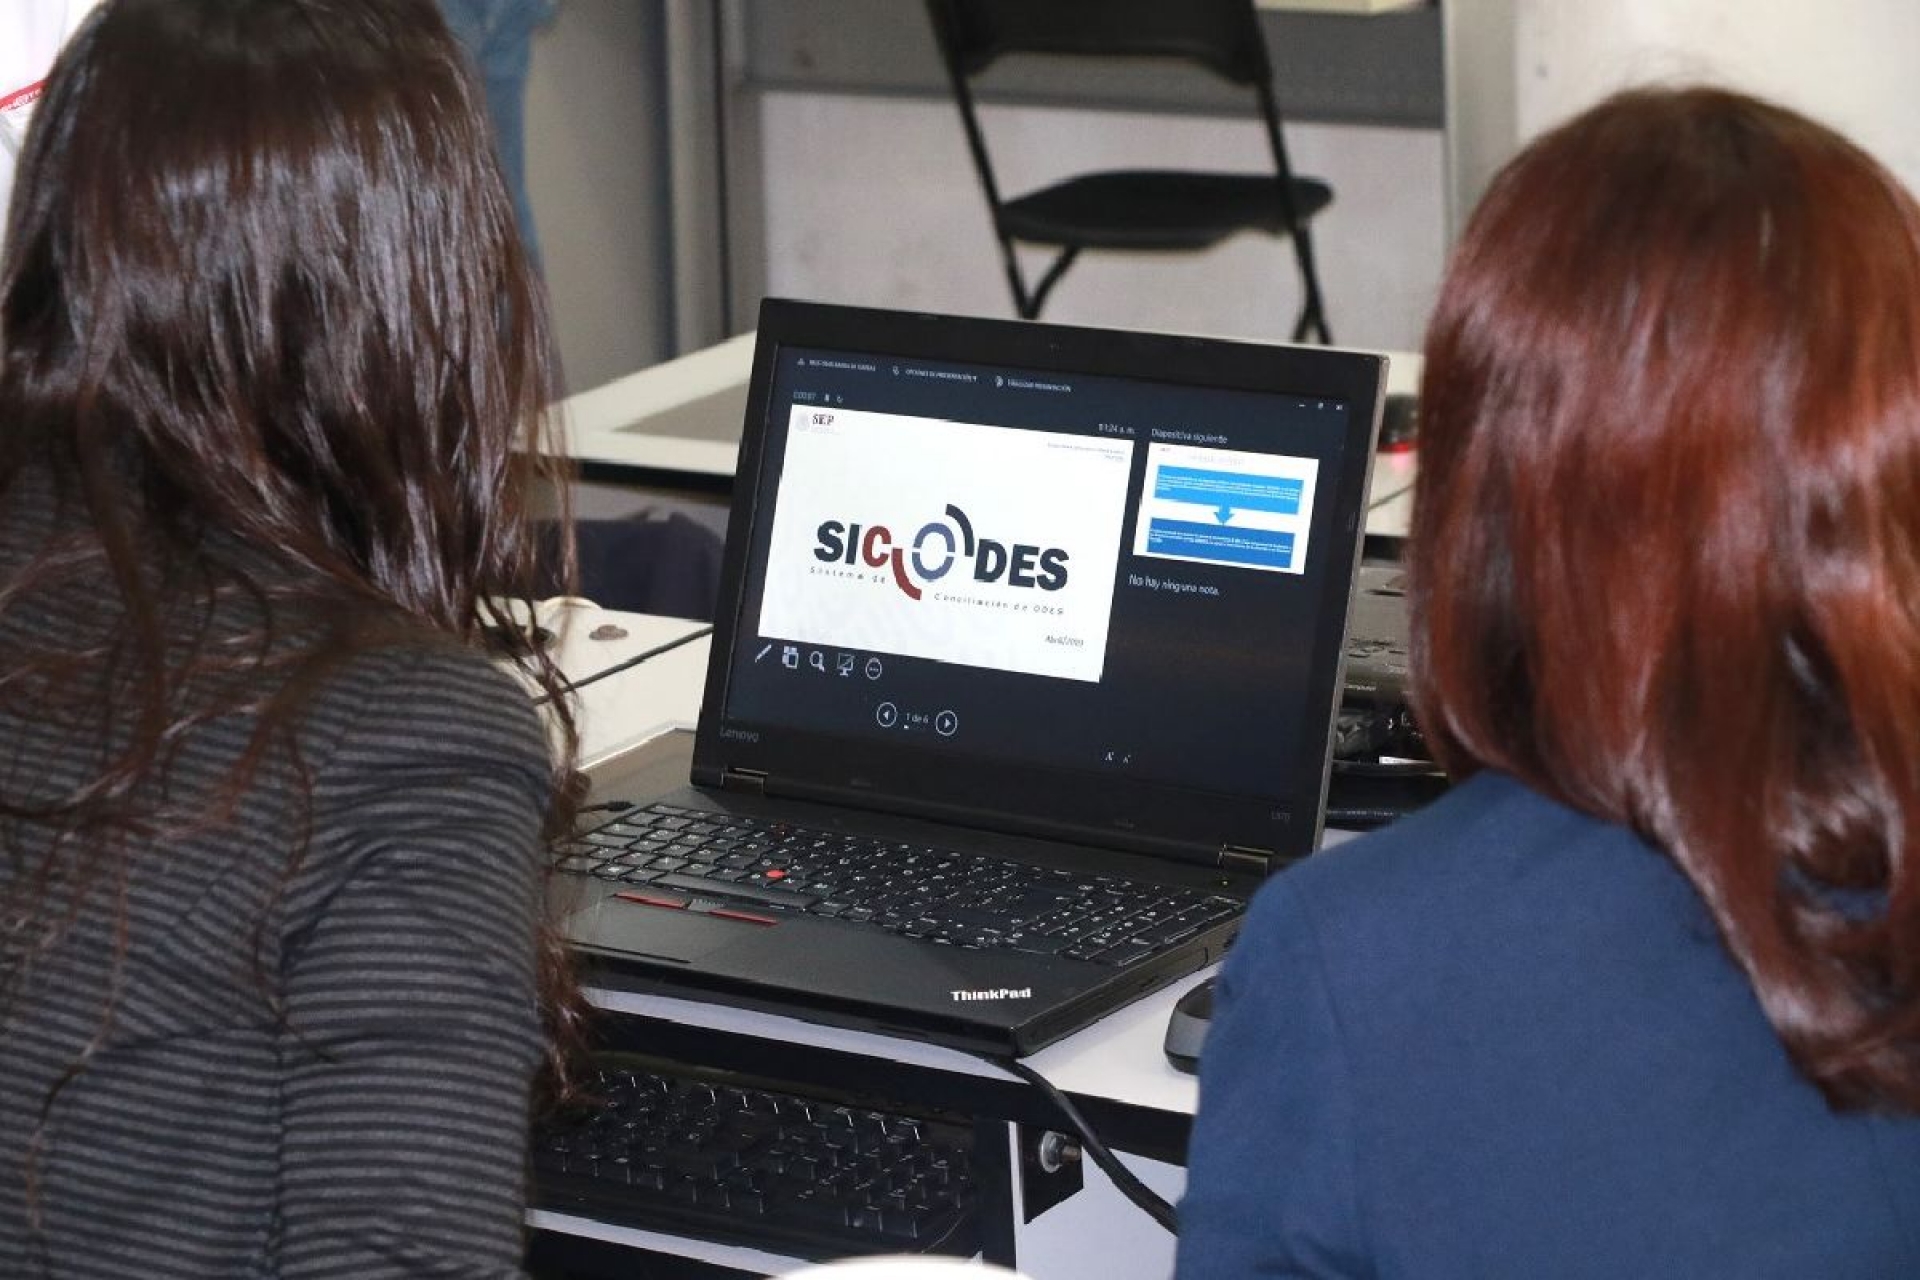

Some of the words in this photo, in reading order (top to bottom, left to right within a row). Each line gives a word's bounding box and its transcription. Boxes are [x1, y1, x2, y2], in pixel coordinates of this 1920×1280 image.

[812, 413, 835, 426] SEP
[719, 725, 759, 743] Lenovo
[950, 987, 1032, 1001] ThinkPad
